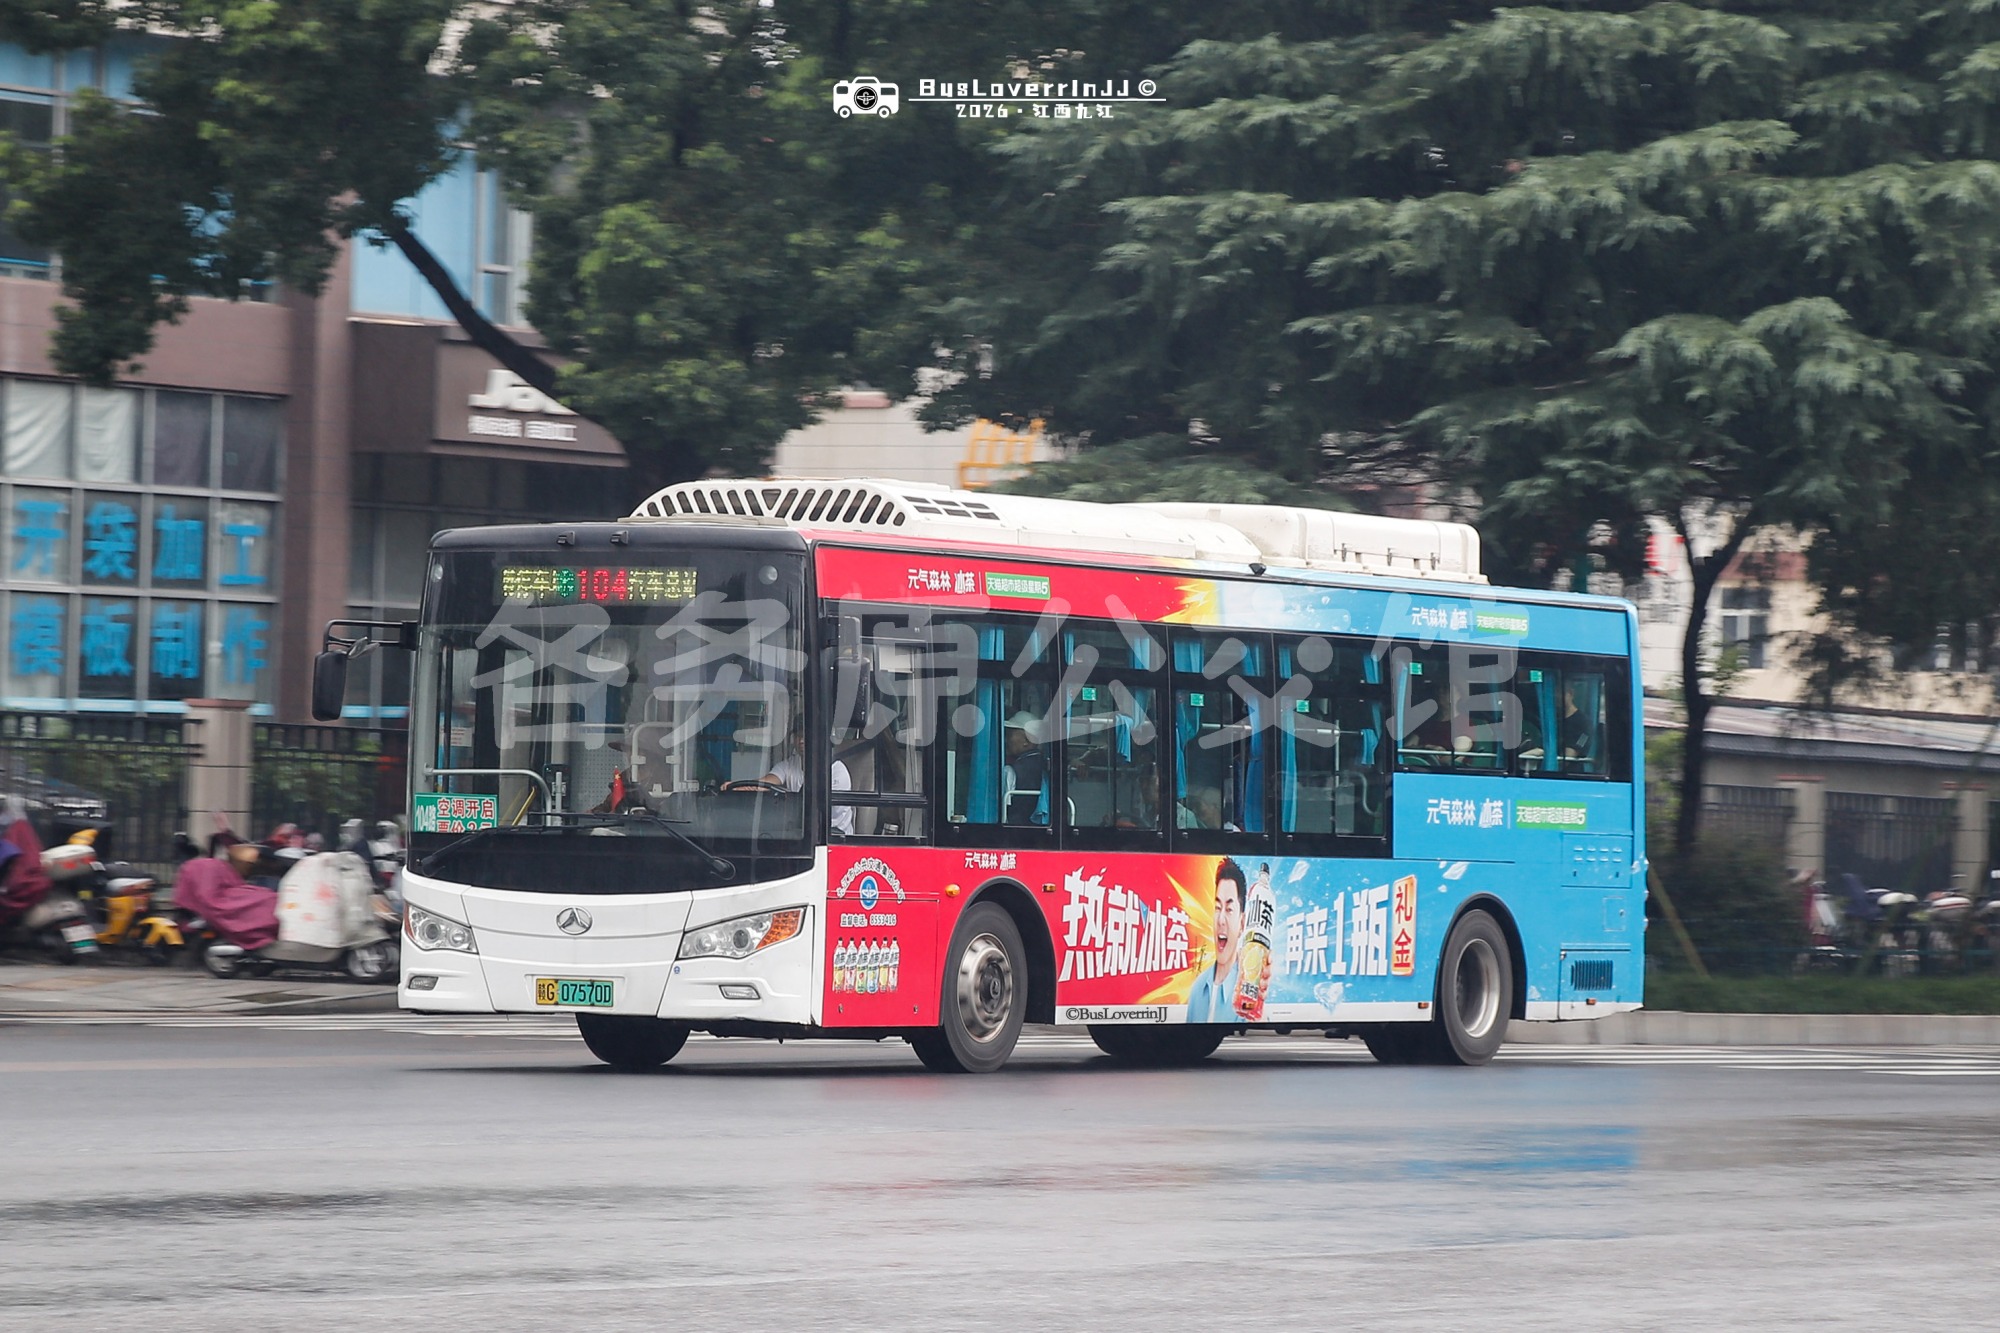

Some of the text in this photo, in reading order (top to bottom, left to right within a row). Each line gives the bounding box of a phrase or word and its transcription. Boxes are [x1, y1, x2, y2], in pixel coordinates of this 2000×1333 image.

[577, 570, 627, 599] 104
[908, 569, 975, 594] 元气森林 冰茶
[1411, 607, 1448, 628] 元气森林
[437, 798, 494, 819] 空调开启
[1427, 798, 1503, 828] 元气森林 冰茶
[965, 852, 1016, 870] 元气森林 冰茶
[1058, 866, 1190, 982] 热就冰茶
[1284, 884, 1389, 976] 再来1瓶
[1393, 884, 1413, 970] 礼金
